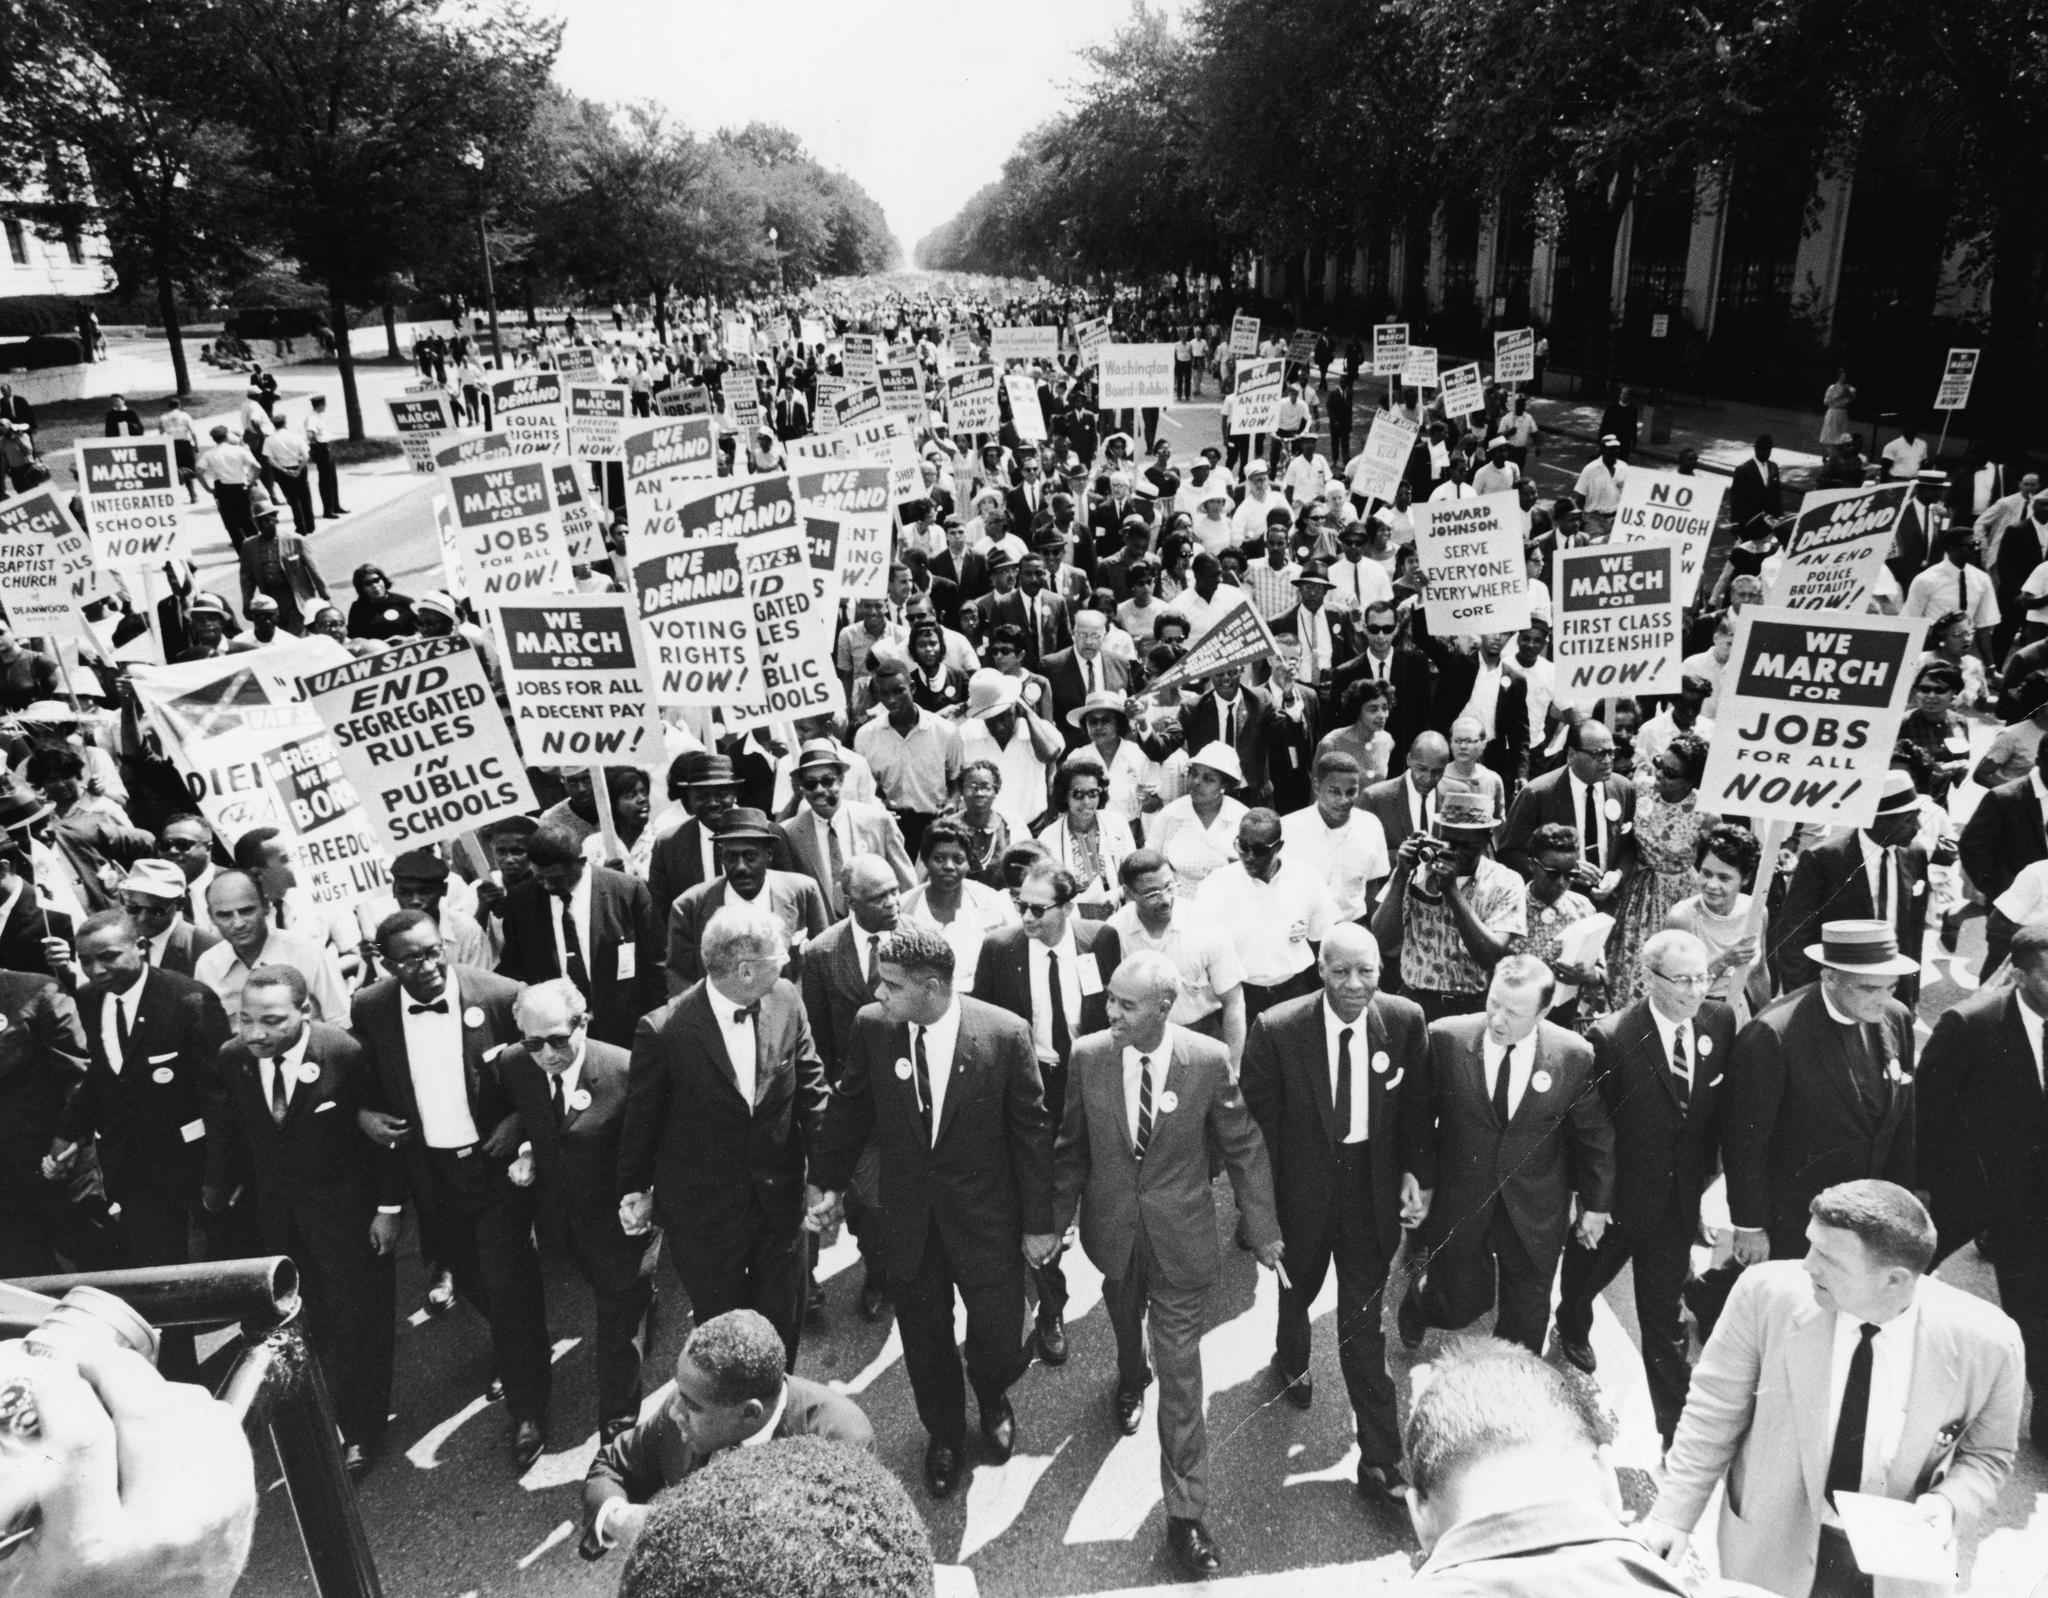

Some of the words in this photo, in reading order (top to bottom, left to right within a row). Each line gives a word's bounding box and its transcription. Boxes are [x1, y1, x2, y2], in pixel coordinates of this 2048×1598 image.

[1104, 360, 1169, 377] Washington
[514, 377, 539, 393] WE
[883, 377, 914, 386] MARCH
[498, 387, 559, 411] DEMAND
[575, 398, 621, 410] MARCH
[590, 391, 606, 399] WE
[953, 398, 967, 409] AN
[405, 403, 422, 412] WE
[664, 402, 692, 416] JOBS
[962, 406, 987, 417] LAW
[1246, 405, 1270, 415] LAW
[1451, 400, 1479, 412] NOW!
[397, 411, 441, 423] MARCH
[507, 416, 557, 426] EQUAL
[956, 416, 994, 428] NOW!
[1238, 415, 1276, 428] NOW!
[652, 425, 684, 449] WE
[111, 448, 138, 462] WE
[578, 444, 622, 455] NOW!
[631, 437, 709, 475] DEMAND
[92, 462, 164, 481] MARCH
[485, 471, 514, 488] WE
[115, 480, 143, 490] FOR
[635, 479, 662, 495] AN
[822, 471, 859, 493] WE
[91, 494, 174, 513] INTEGRATED
[464, 483, 543, 514] MARCH
[715, 486, 756, 518] WE
[1650, 483, 1693, 507] NO
[1, 507, 29, 526] WE
[491, 507, 523, 520] FOR
[1432, 506, 1491, 524] HOWARD
[1831, 495, 1876, 522] WE
[95, 514, 177, 533] SCHOOLS
[1428, 519, 1498, 537] JOHNSON
[1621, 507, 1646, 528] U.S.
[1651, 512, 1710, 537] DOUGH
[1796, 507, 1895, 552] DEMAND
[107, 532, 176, 558] NOW!
[474, 522, 549, 555] JOBS
[2, 544, 44, 557] FIRST
[480, 556, 513, 568] FOR
[523, 548, 551, 560] ALL
[1444, 541, 1488, 559] SERVE
[1796, 554, 1830, 566] AN
[1833, 548, 1873, 563] END
[0, 559, 55, 574] BAPTIST
[665, 551, 705, 580] WE
[747, 547, 796, 574] AYS:
[1600, 556, 1633, 573] WE
[484, 560, 558, 593] NOW!
[1428, 560, 1514, 581] EVERYONE
[1807, 568, 1853, 582] POLICE
[2, 575, 57, 588] CHURCH
[644, 568, 739, 612] DEMAND
[1426, 580, 1521, 601] EVERYWHERE
[1570, 570, 1663, 597] MARCH
[1789, 579, 1858, 596] BRUTALITY
[1599, 595, 1635, 606] FOR
[1786, 586, 1865, 610] NOW!
[12, 605, 69, 615] DEANWOOD
[1452, 604, 1494, 619] CORE
[542, 612, 583, 629] WE
[649, 621, 747, 639] VOTING
[1563, 617, 1610, 636] FIRST
[1619, 613, 1672, 631] CLASS
[516, 632, 623, 653] MARCH
[1559, 634, 1674, 656] CITIZENSHIP
[1805, 632, 1853, 654] WE
[314, 660, 373, 692] UAW
[381, 636, 461, 671] SAYS:
[552, 657, 593, 667] FOR
[660, 646, 745, 664] RIGHTS
[1571, 657, 1666, 688] NOW!
[1751, 653, 1889, 686] MARCH
[516, 681, 561, 695] JOBS
[566, 681, 603, 695] FOR
[609, 679, 643, 694] ALL
[662, 666, 749, 693] NOW!
[351, 666, 448, 714] END
[1789, 686, 1841, 700] FOR
[334, 683, 485, 747] SEGREGATED
[520, 706, 534, 719] A
[536, 705, 603, 719] DECENT
[609, 703, 645, 717] PAY
[366, 715, 474, 766] RULES
[542, 726, 645, 754] NOW!
[1738, 713, 1870, 749] JOBS
[1737, 749, 1790, 764] FOR
[1808, 756, 1856, 769] ALL
[295, 772, 319, 791] WE
[381, 757, 503, 813] PUBLIC
[1723, 773, 1862, 809] NOW!
[388, 782, 518, 841] SCHOOLS
[312, 872, 330, 886] WE
[312, 883, 348, 904] MUST
[350, 859, 393, 893] LIVE
